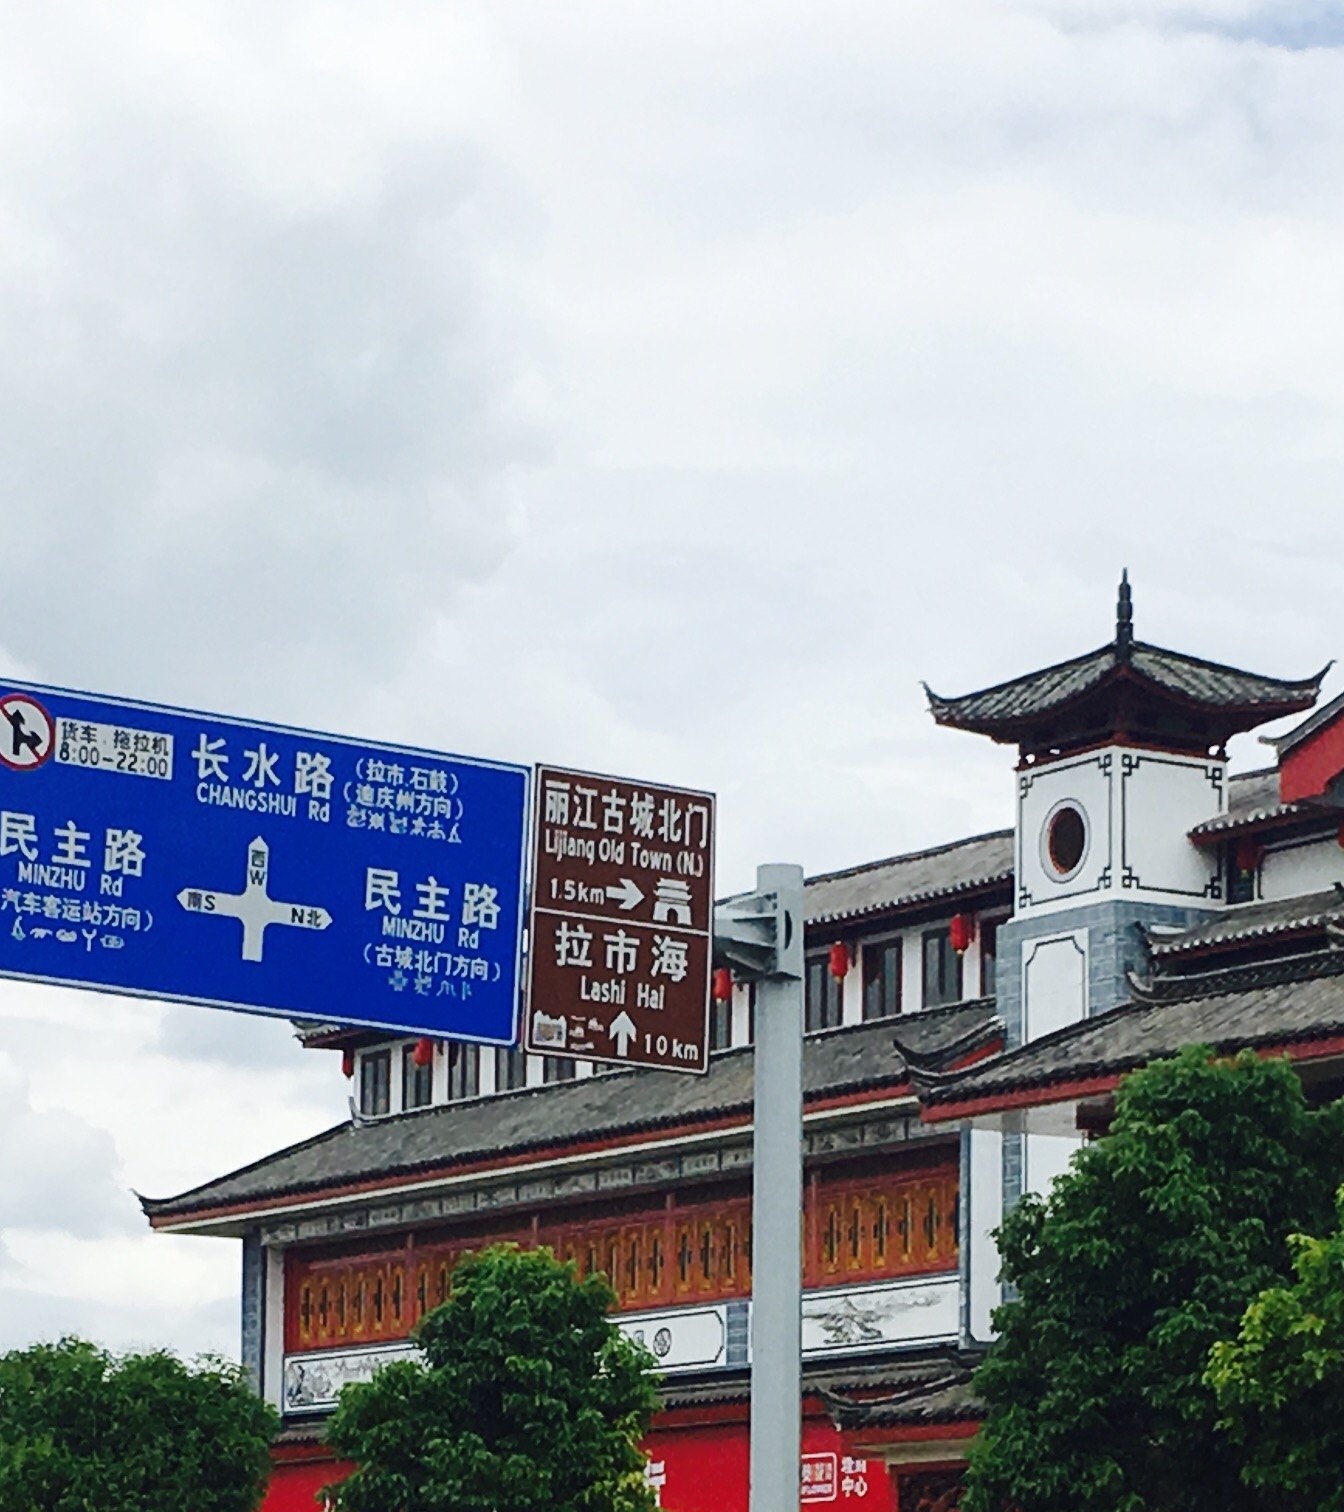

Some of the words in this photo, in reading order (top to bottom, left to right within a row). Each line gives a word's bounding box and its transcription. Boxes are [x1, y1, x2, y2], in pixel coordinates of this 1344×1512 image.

[59, 741, 168, 777] 8:00-22:00
[191, 732, 335, 800] 长水路
[196, 782, 297, 817] CHANGSHUI
[308, 800, 331, 823] Rd
[545, 779, 708, 849] 丽江古城北门
[544, 828, 595, 867] Lijiang
[600, 838, 626, 866] Old
[630, 842, 673, 873] Town
[17, 860, 86, 892] MINZHU
[99, 874, 124, 897] Rd
[250, 870, 266, 886] W
[364, 867, 502, 930] 民主路
[382, 915, 445, 944] MINZHU
[458, 928, 479, 949] Rd
[555, 920, 689, 983] 拉市海
[580, 975, 626, 1006] Lashi
[637, 982, 666, 1012] Hai
[672, 1037, 699, 1060] km
[841, 1475, 868, 1497] 中心
